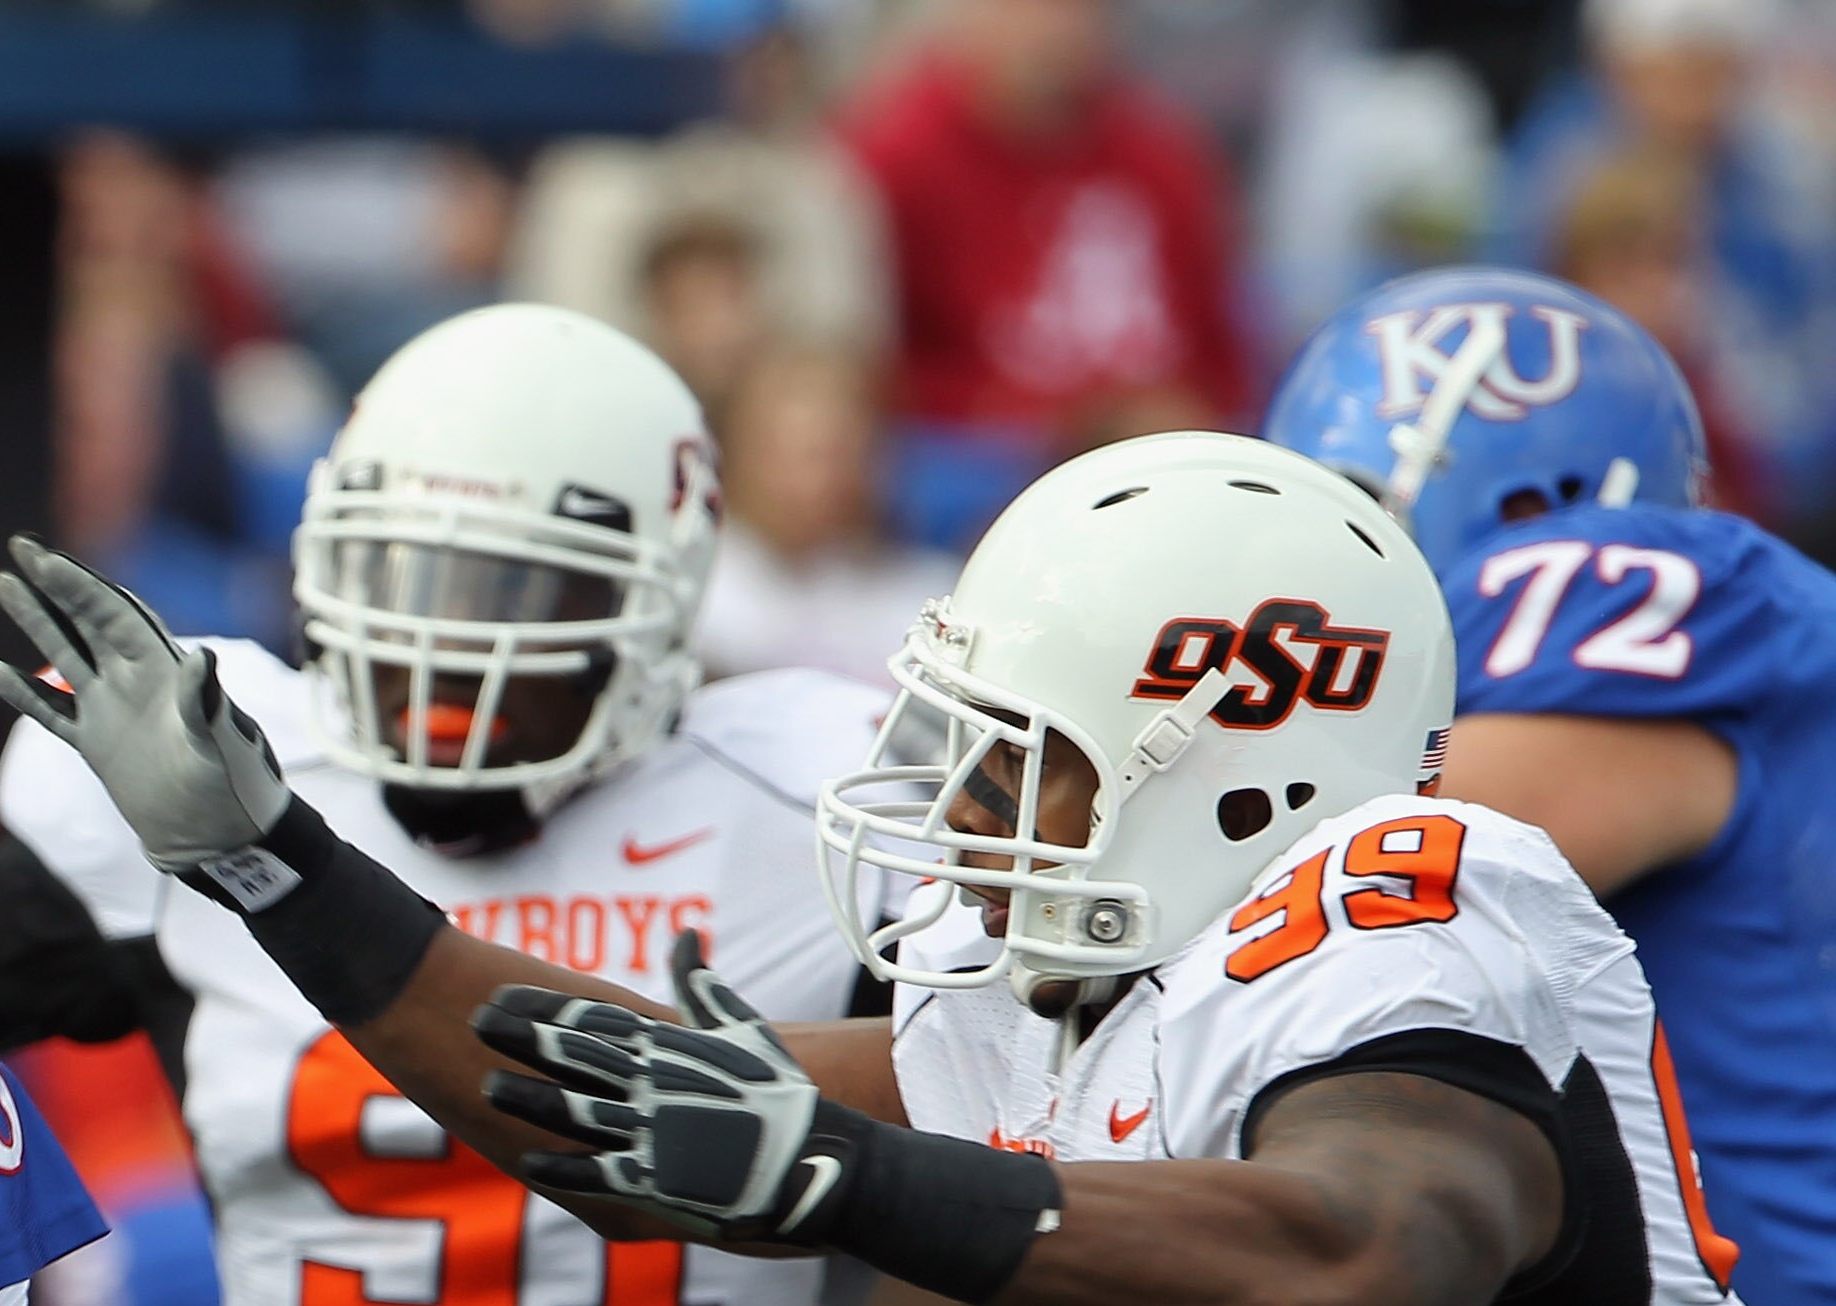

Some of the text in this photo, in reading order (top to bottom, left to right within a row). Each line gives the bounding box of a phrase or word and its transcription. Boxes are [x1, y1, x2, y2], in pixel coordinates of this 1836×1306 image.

[1368, 303, 1586, 422] KU
[1127, 597, 1391, 731] OSU
[1480, 541, 1701, 680] 72
[1224, 814, 1467, 984] 99
